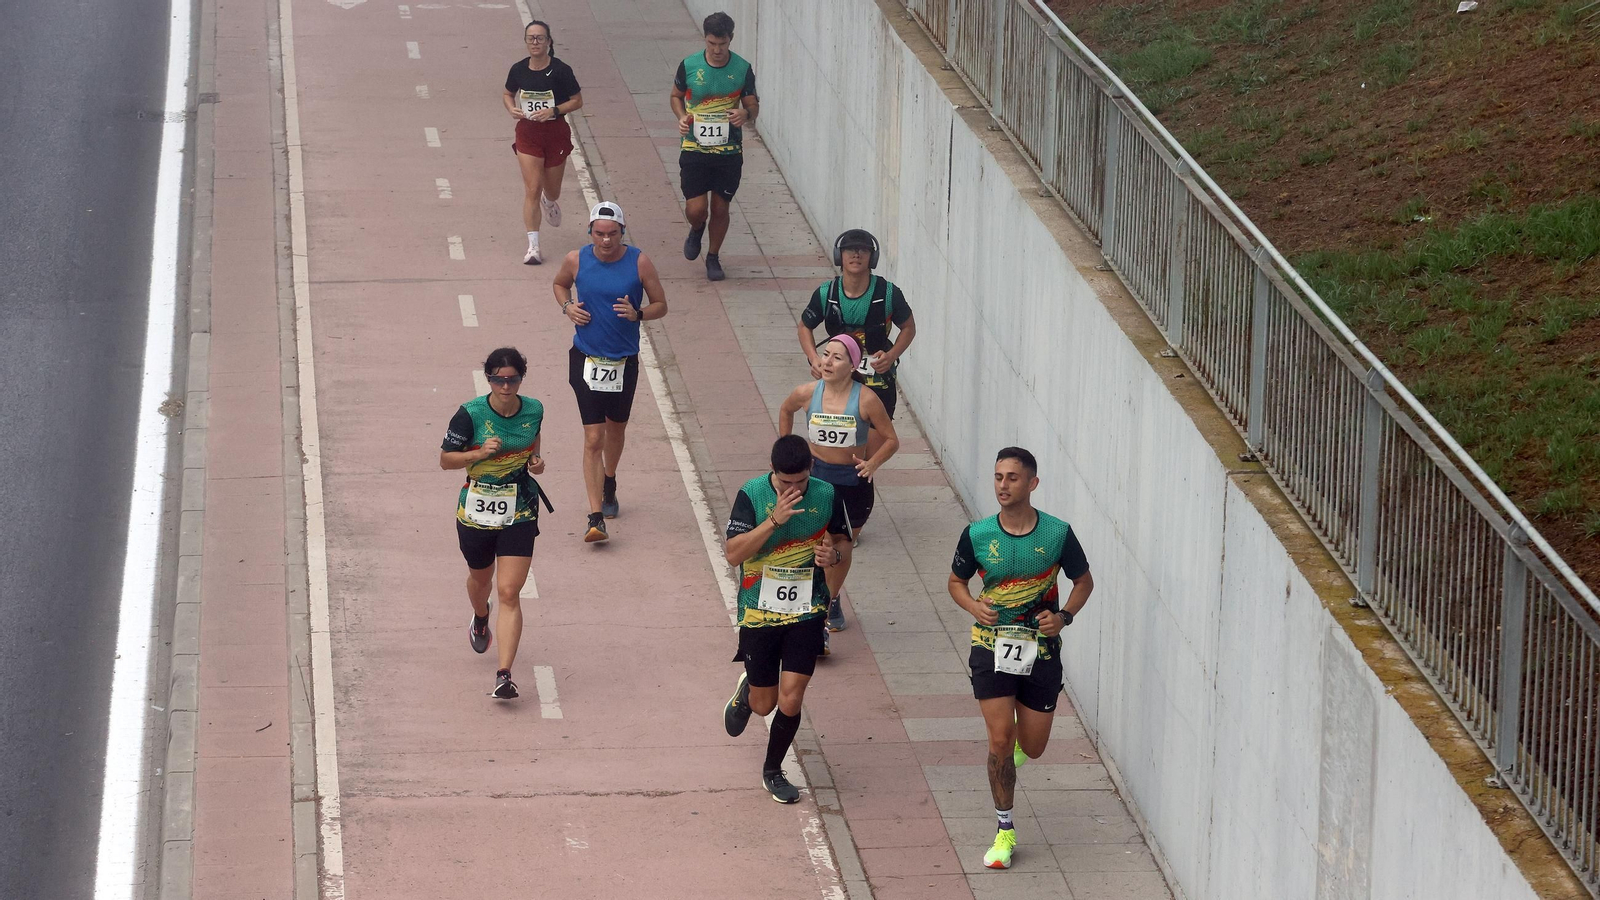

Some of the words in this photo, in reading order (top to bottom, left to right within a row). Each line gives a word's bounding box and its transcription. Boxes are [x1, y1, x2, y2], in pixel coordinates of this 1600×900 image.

[527, 101, 549, 112] 365
[700, 125, 723, 137] 211
[591, 366, 618, 382] 170
[817, 429, 849, 445] 397
[475, 498, 508, 515] 349
[776, 585, 798, 602] 66
[1002, 643, 1022, 662] 71
